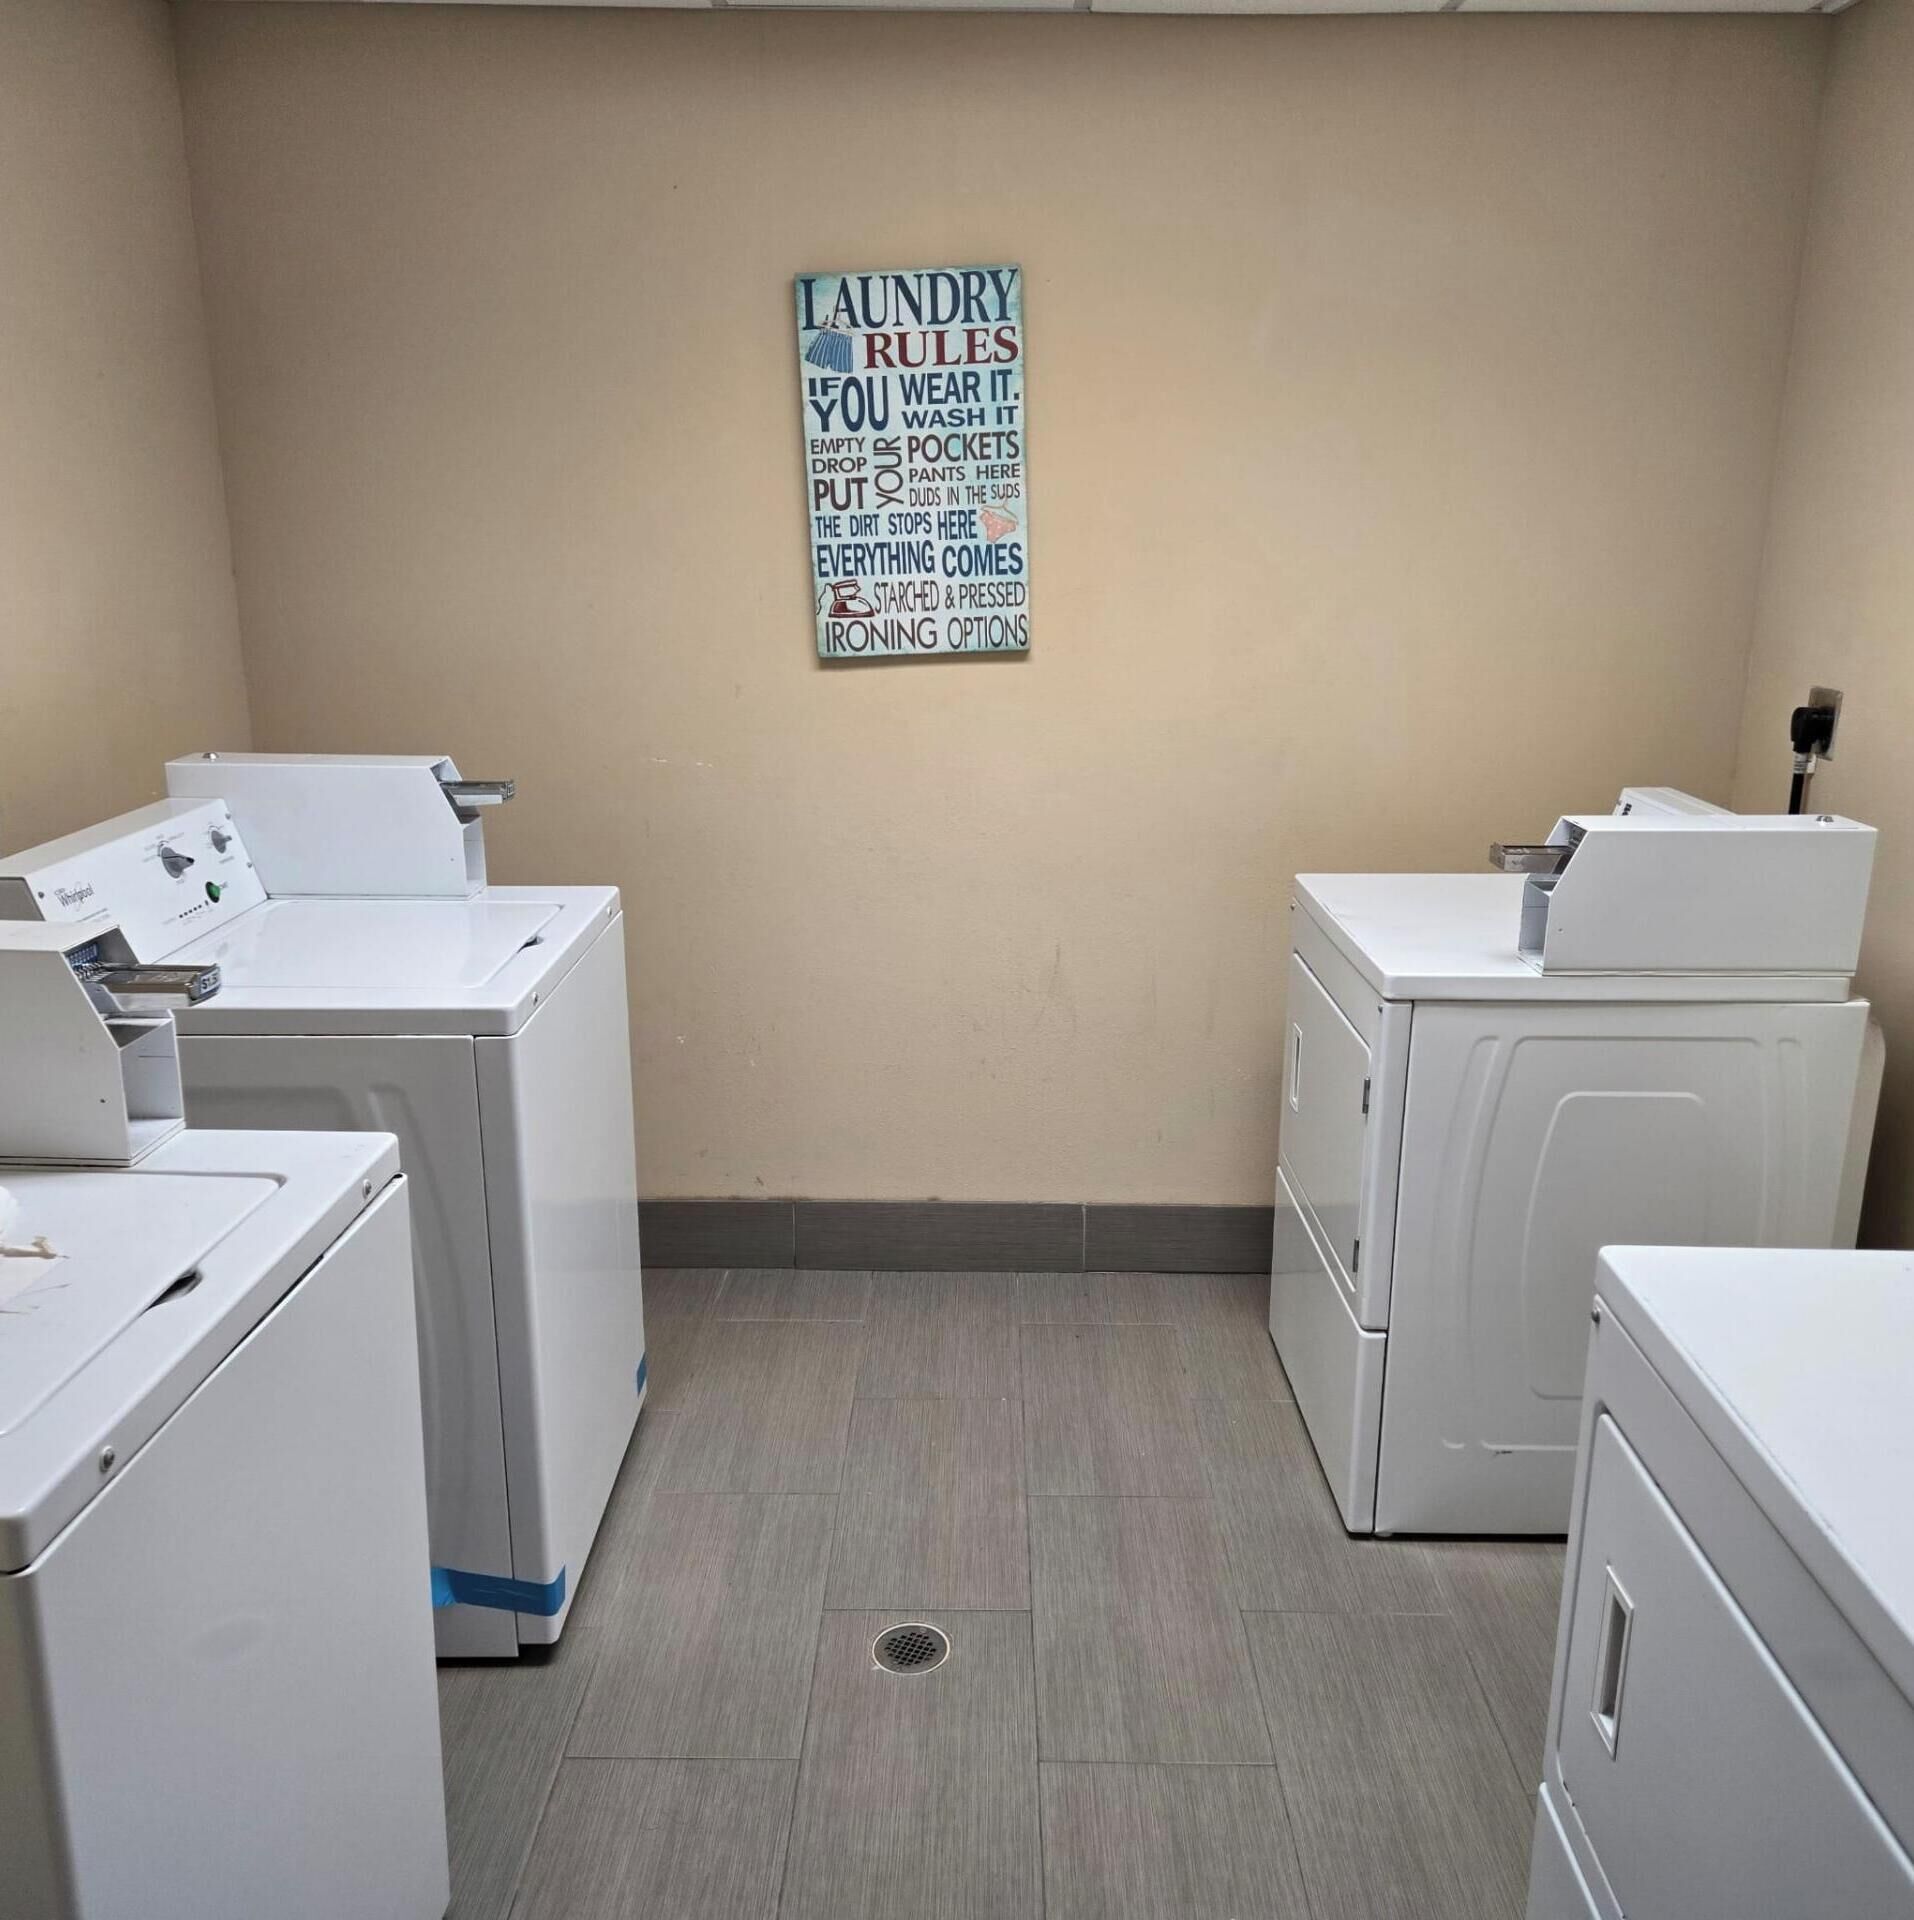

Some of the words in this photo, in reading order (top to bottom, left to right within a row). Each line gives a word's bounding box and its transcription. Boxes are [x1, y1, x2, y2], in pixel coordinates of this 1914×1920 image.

[800, 268, 1018, 331] LAUNDRY
[863, 326, 1019, 369] RULES
[808, 377, 842, 397] IF
[809, 376, 889, 432] YOU
[899, 371, 981, 406] WEAR
[901, 408, 985, 429] WASH
[996, 406, 1019, 425] IT
[810, 437, 866, 455] EMPTY
[907, 430, 1020, 463] POCKETS
[812, 456, 868, 474] DROP
[872, 435, 905, 510] YOUR
[909, 466, 966, 483] PANTS
[976, 463, 1021, 480] HERE
[813, 477, 869, 511] PUT
[909, 486, 941, 507] DUDS
[947, 486, 960, 506] IN
[965, 484, 987, 505] THE
[990, 482, 1021, 501] SUDS
[815, 515, 842, 538] THE
[850, 513, 880, 537] DIRT
[888, 511, 933, 536] STOPS
[937, 509, 978, 540] HERE
[816, 540, 936, 578] EVERYTHING
[941, 542, 1024, 578] COMES
[873, 580, 940, 614] STARCHED
[945, 584, 956, 610] &
[959, 581, 1027, 609] PRESSED
[825, 617, 938, 653] IRONING
[947, 613, 1028, 650] OPTIONS
